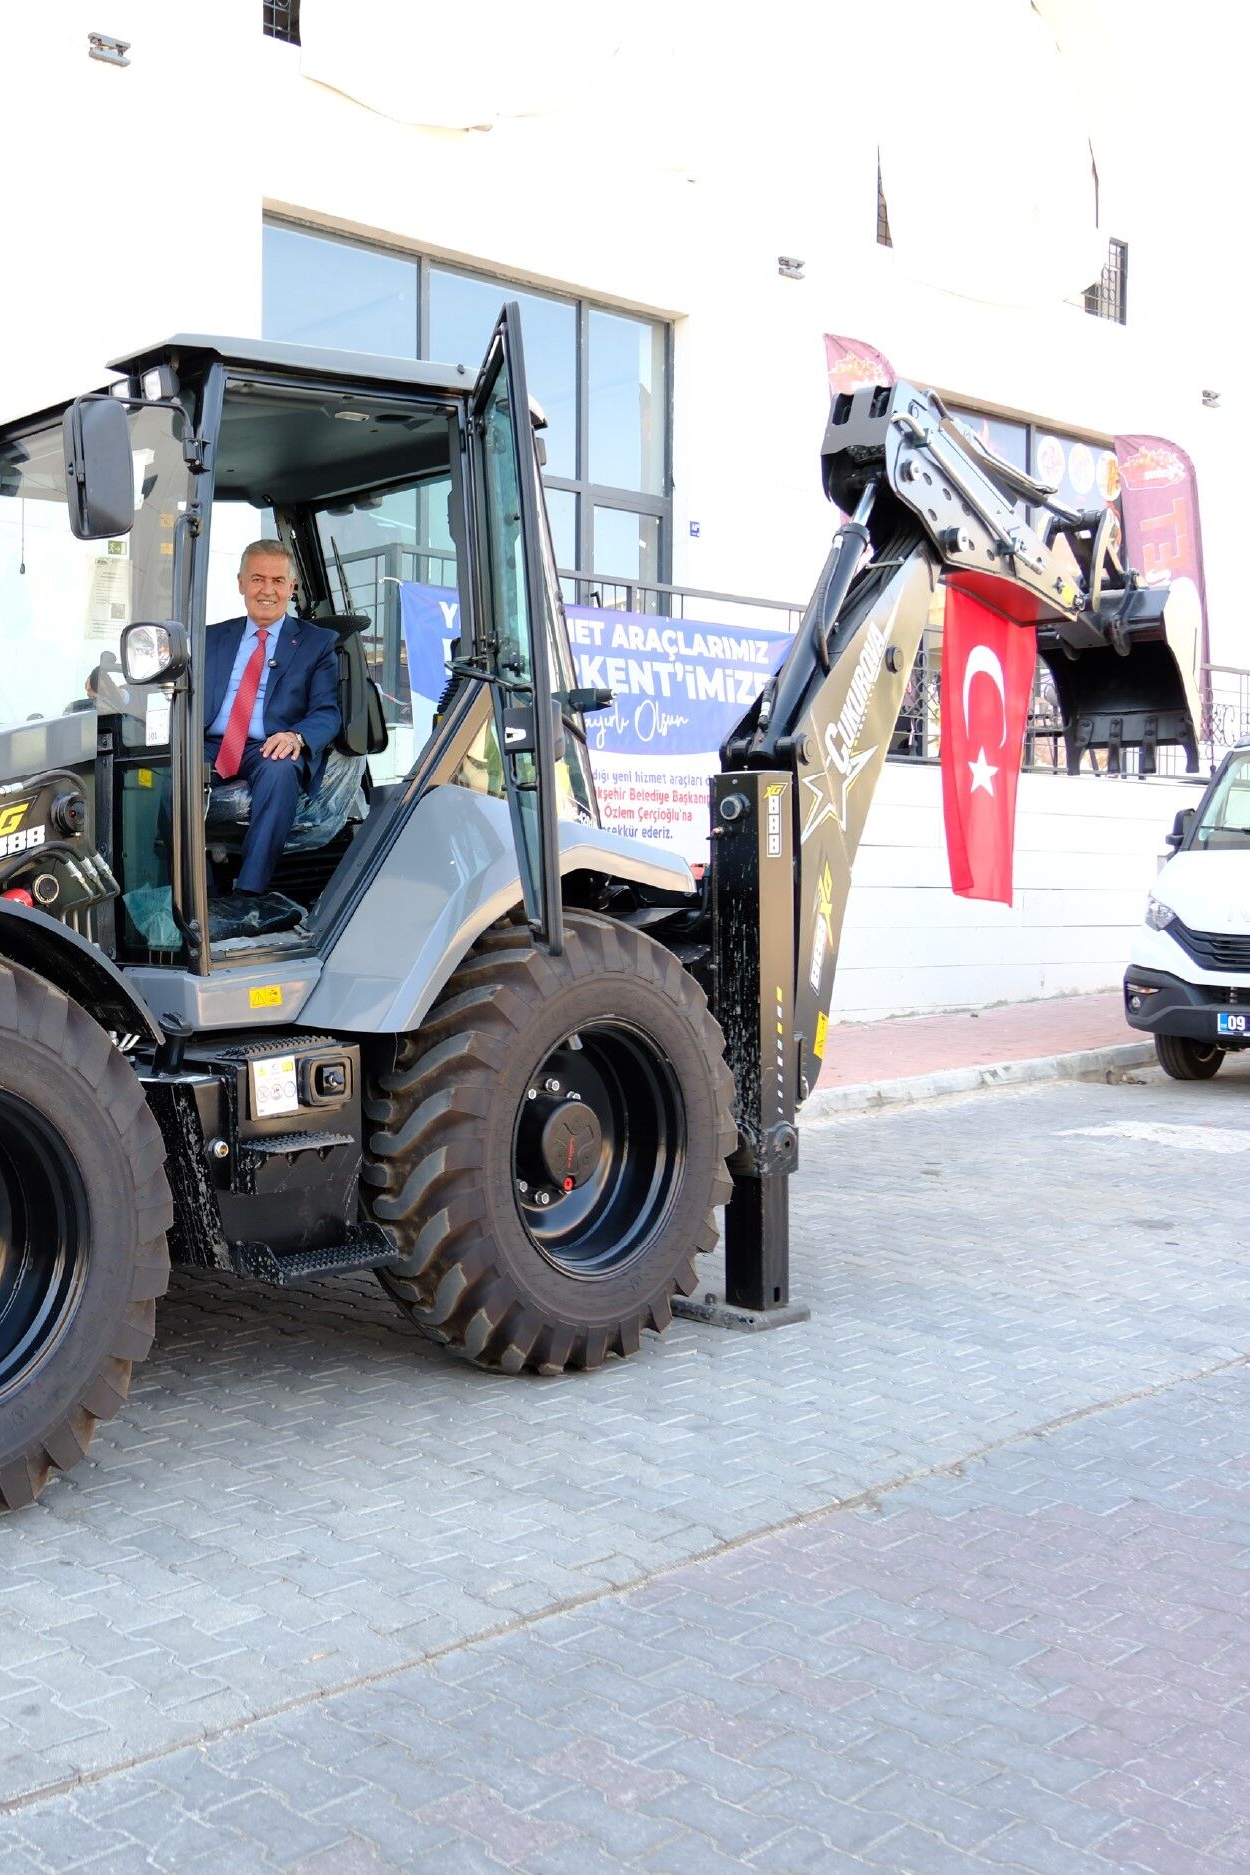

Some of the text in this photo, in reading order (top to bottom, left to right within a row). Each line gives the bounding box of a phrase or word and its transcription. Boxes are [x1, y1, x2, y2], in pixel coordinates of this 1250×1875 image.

[611, 626, 770, 664] ARAÇLARIMIZ
[584, 699, 690, 750] ayırlı Olsun
[612, 771, 632, 786] yeni
[635, 770, 666, 785] hizmet
[669, 773, 703, 788] araçları
[596, 785, 626, 804] kşehir
[629, 788, 670, 805] Belediye
[604, 803, 635, 819] Özlem
[637, 806, 693, 824] Çerçioğlu'na
[641, 825, 673, 839] ederiz.
[1227, 1015, 1246, 1031] 09
